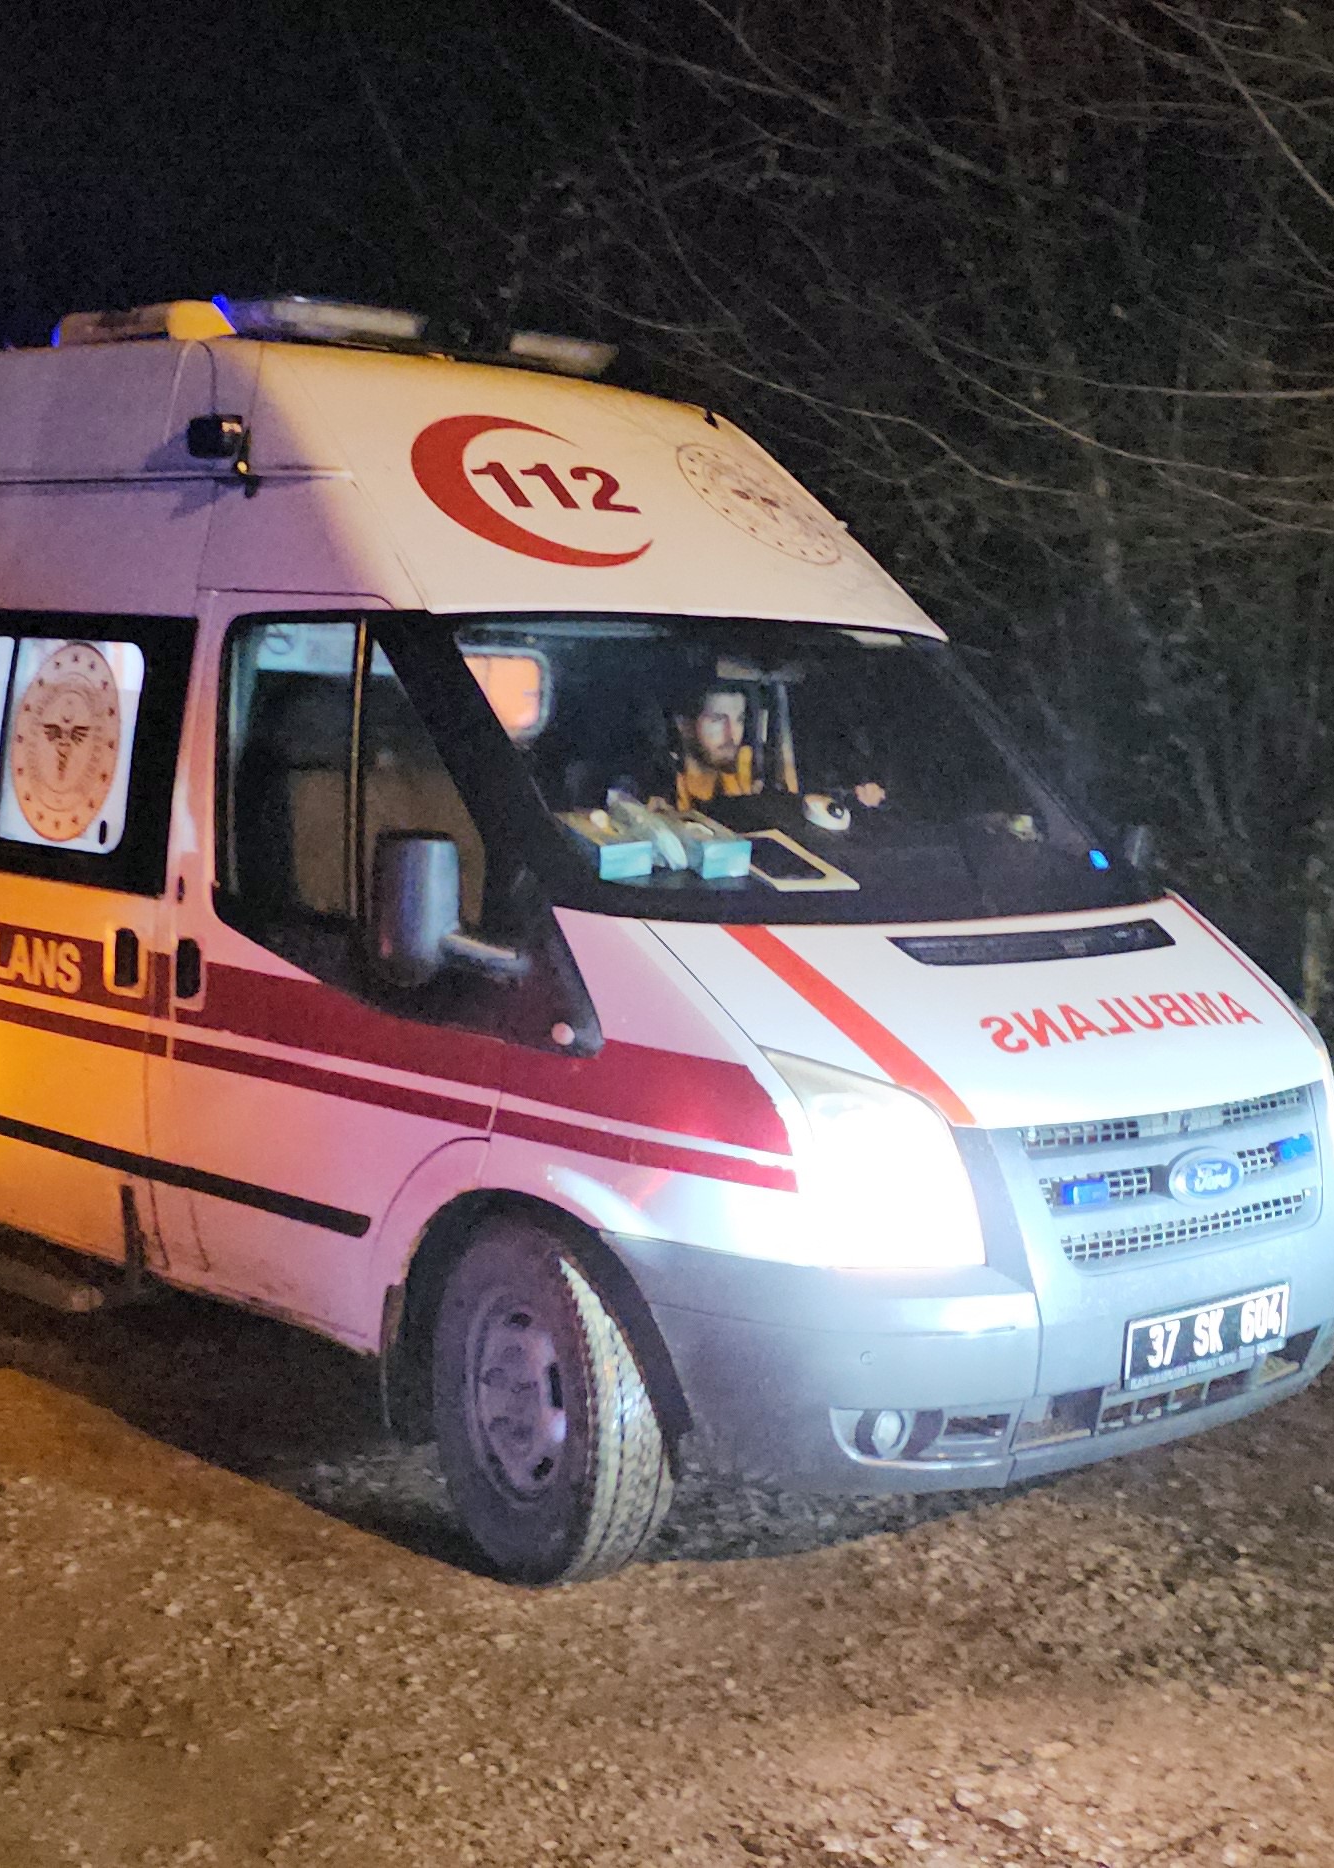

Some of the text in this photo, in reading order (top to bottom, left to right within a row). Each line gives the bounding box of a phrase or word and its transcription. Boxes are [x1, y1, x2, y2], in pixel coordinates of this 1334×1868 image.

[470, 462, 642, 514] 112
[1194, 1162, 1232, 1192] Ford
[1147, 1292, 1281, 1368] 37 SK 604
